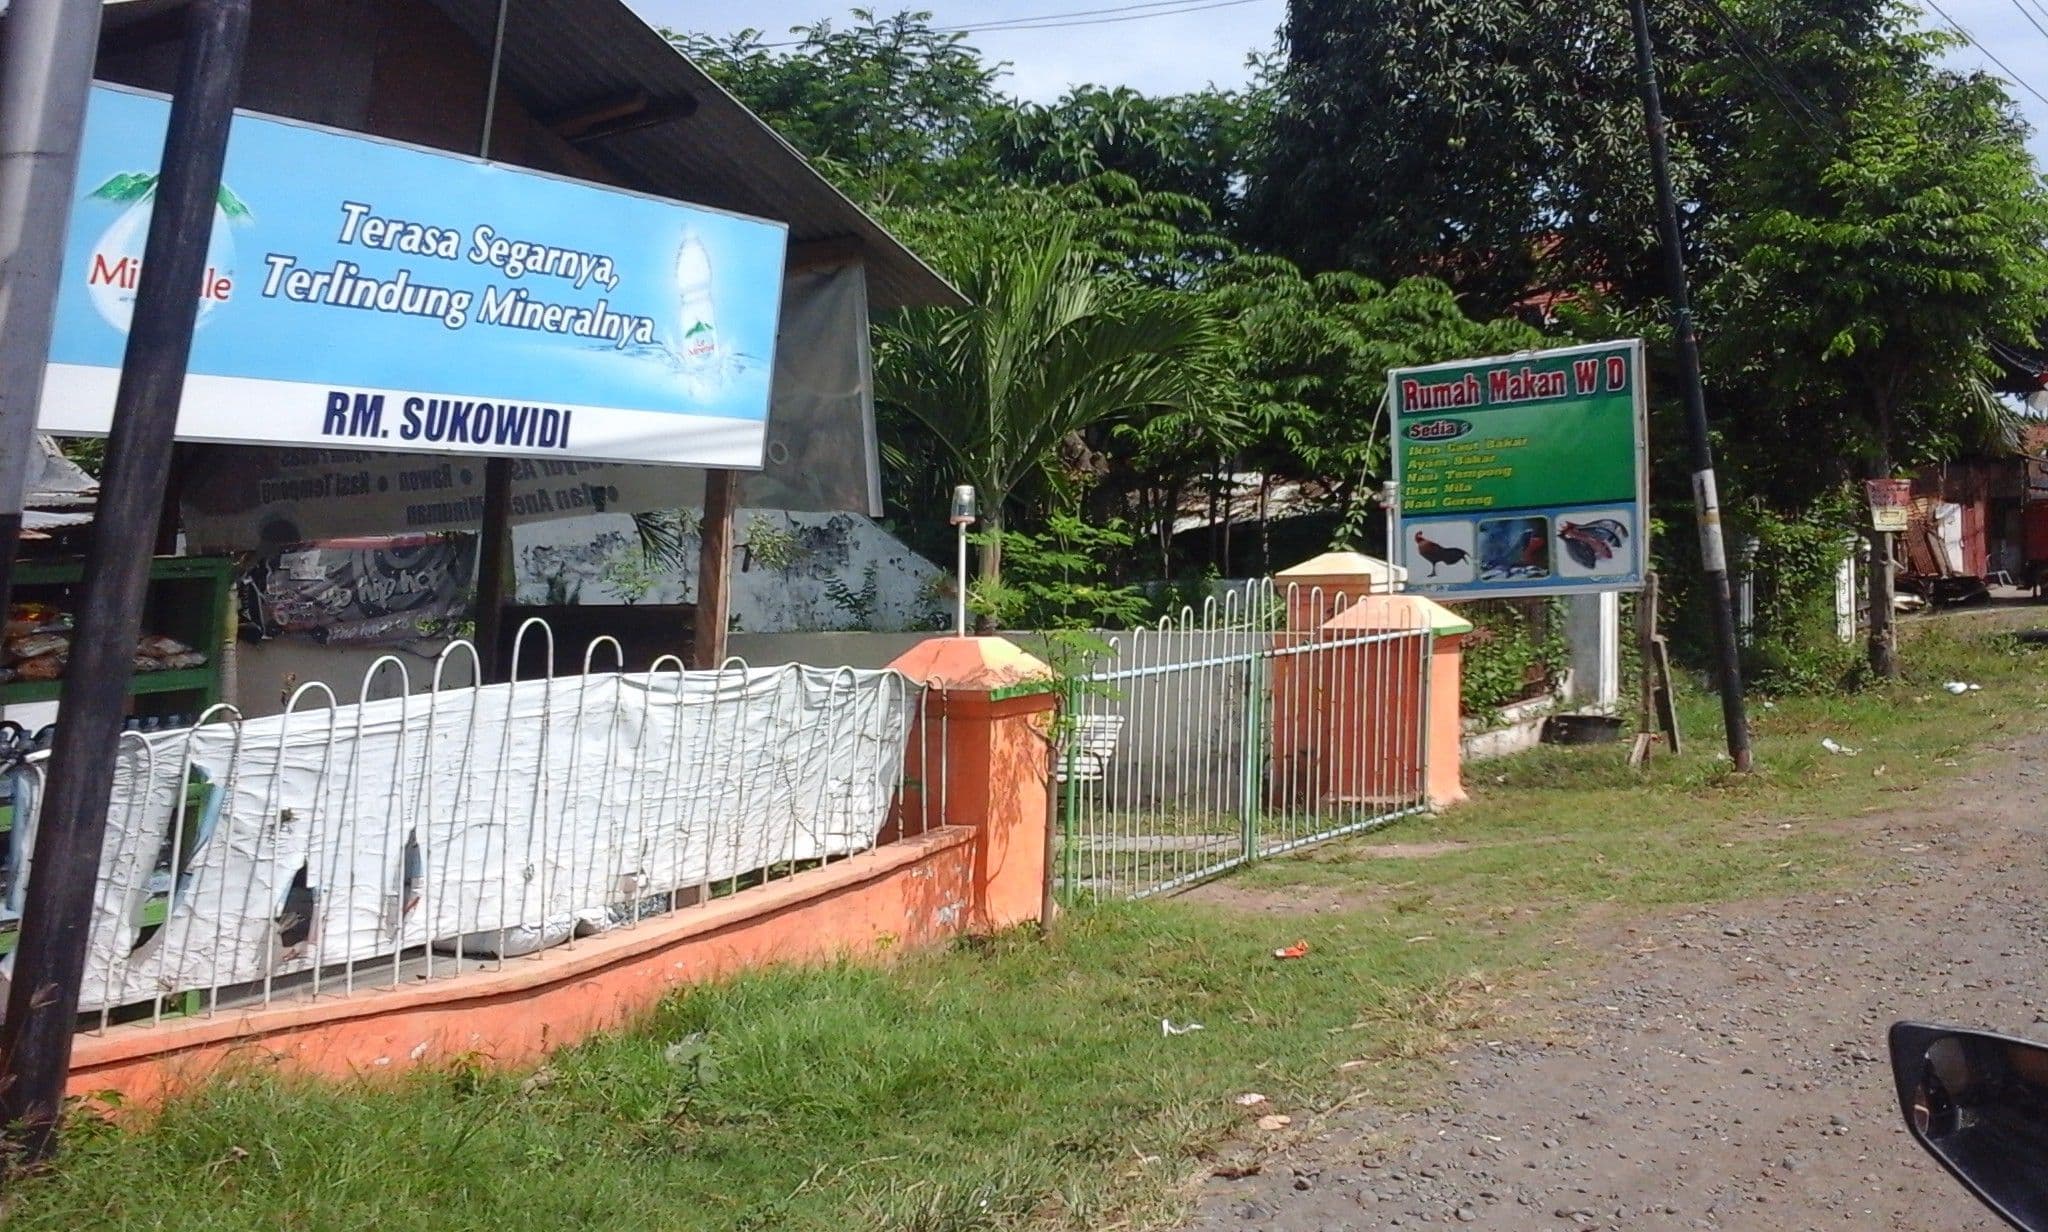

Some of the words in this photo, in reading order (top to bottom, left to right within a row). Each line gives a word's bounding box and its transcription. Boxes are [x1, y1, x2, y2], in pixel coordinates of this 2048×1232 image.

[338, 201, 460, 260] Terasa
[467, 224, 619, 293] Segarnya,
[89, 253, 232, 300] Mile
[262, 253, 474, 330] Terlindung
[477, 284, 655, 350] Mineralnya
[1402, 373, 1482, 413] Rumah
[1488, 366, 1568, 404] Makan
[322, 391, 388, 438] RM.
[400, 397, 572, 449] SUKOWIDI
[1409, 420, 1457, 439] Sedia
[1407, 459, 1448, 470] Ayam
[1404, 499, 1437, 510] Nasi
[1442, 496, 1494, 507] Goreng
